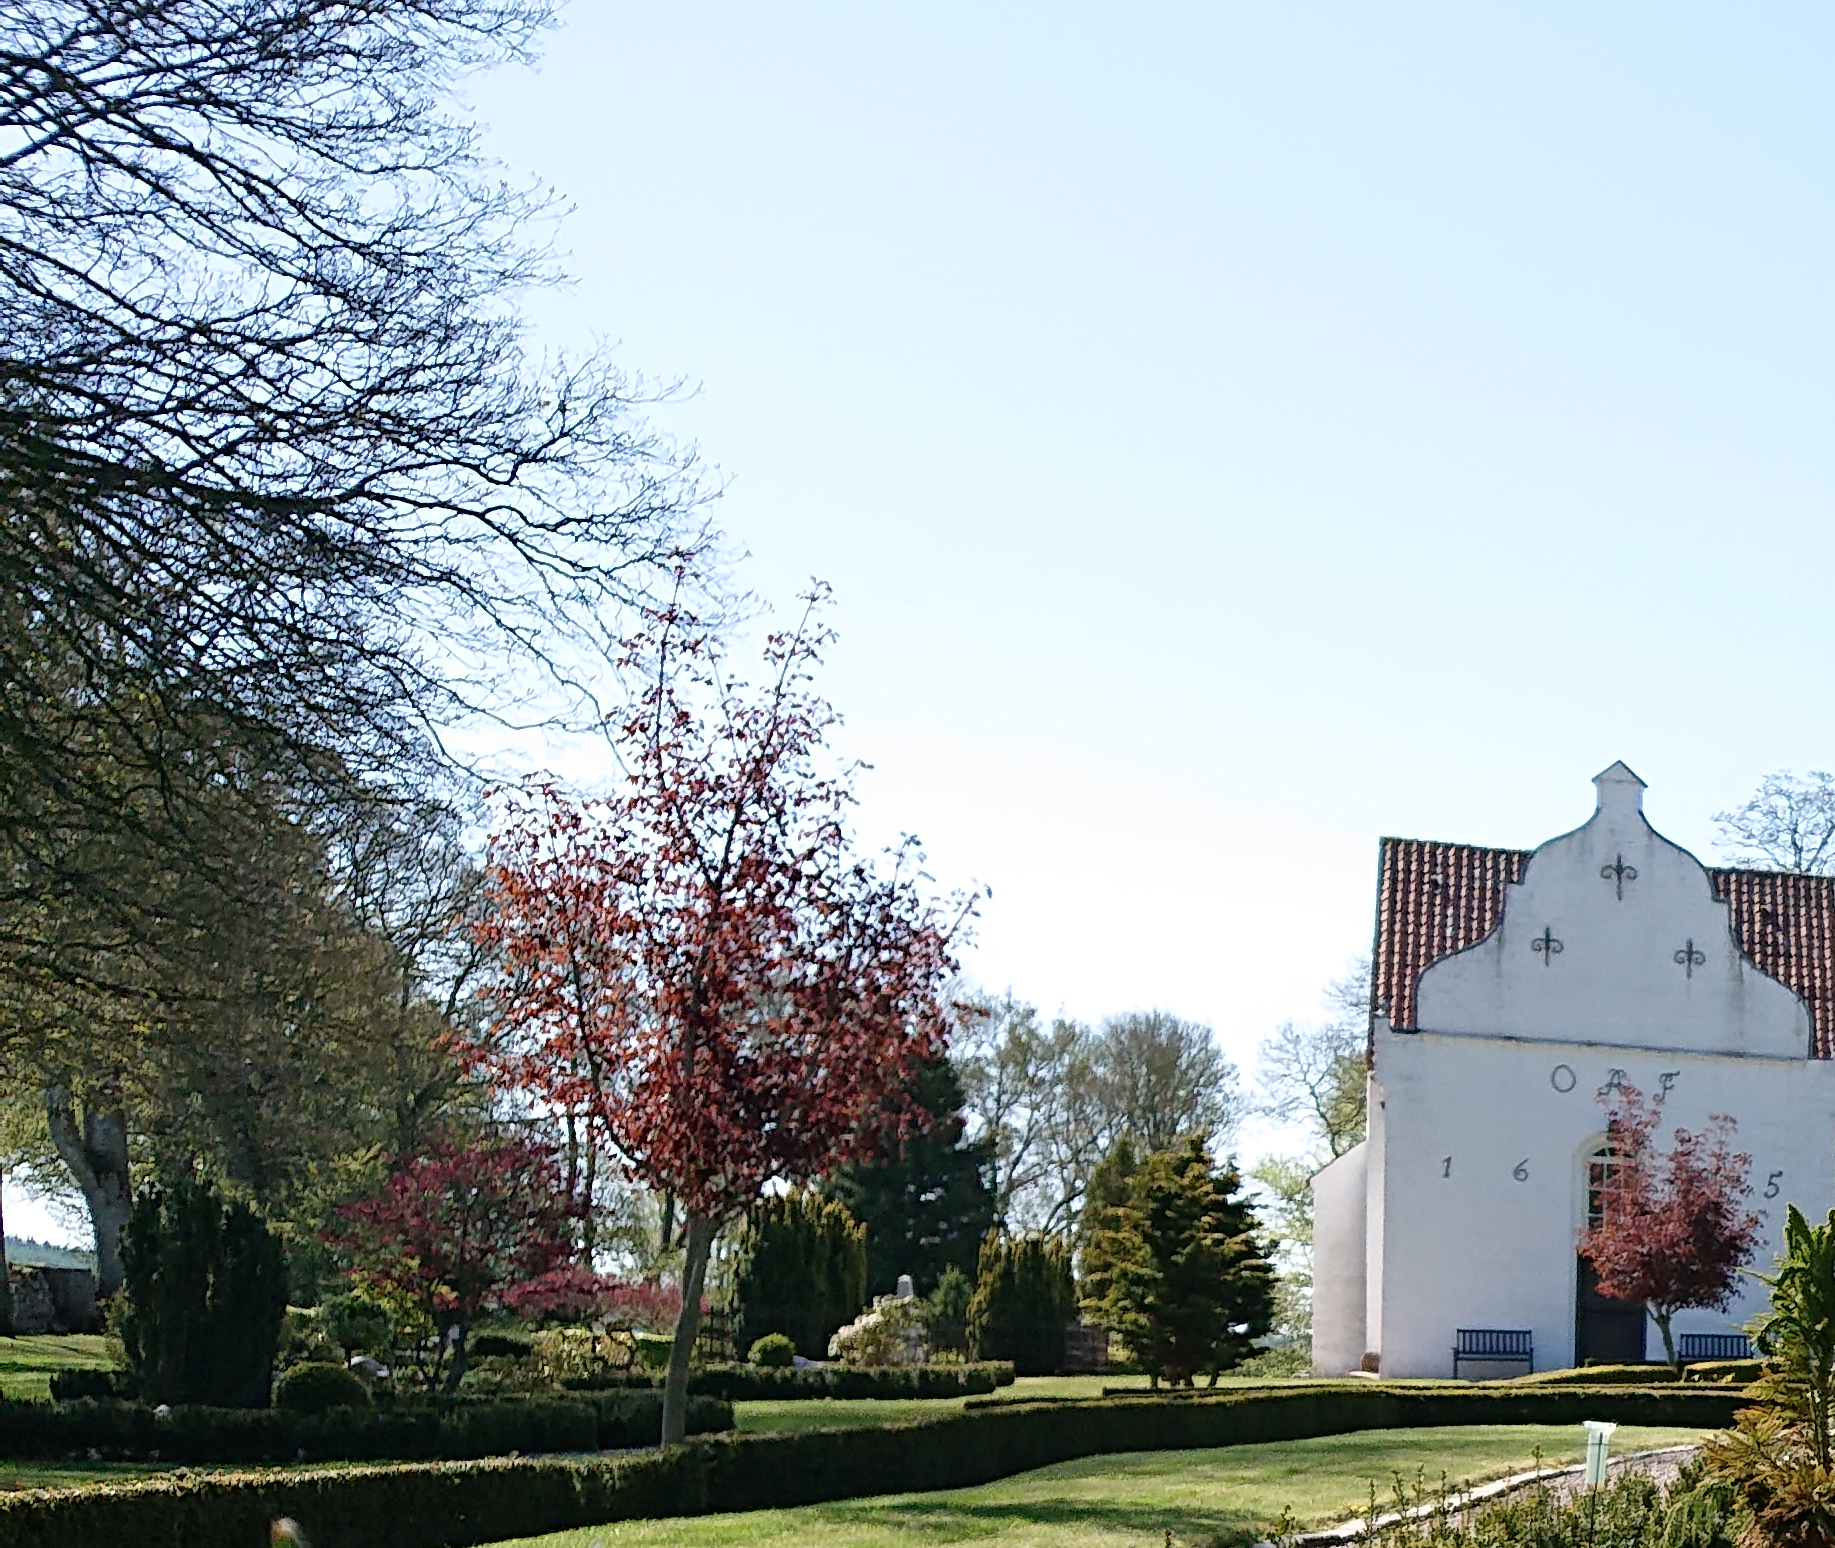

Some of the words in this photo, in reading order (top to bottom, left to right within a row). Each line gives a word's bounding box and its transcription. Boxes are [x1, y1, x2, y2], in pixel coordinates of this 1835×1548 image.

[1442, 1156, 1452, 1179] 1
[1513, 1158, 1530, 1182] 6
[1763, 1170, 1783, 1199] 5
